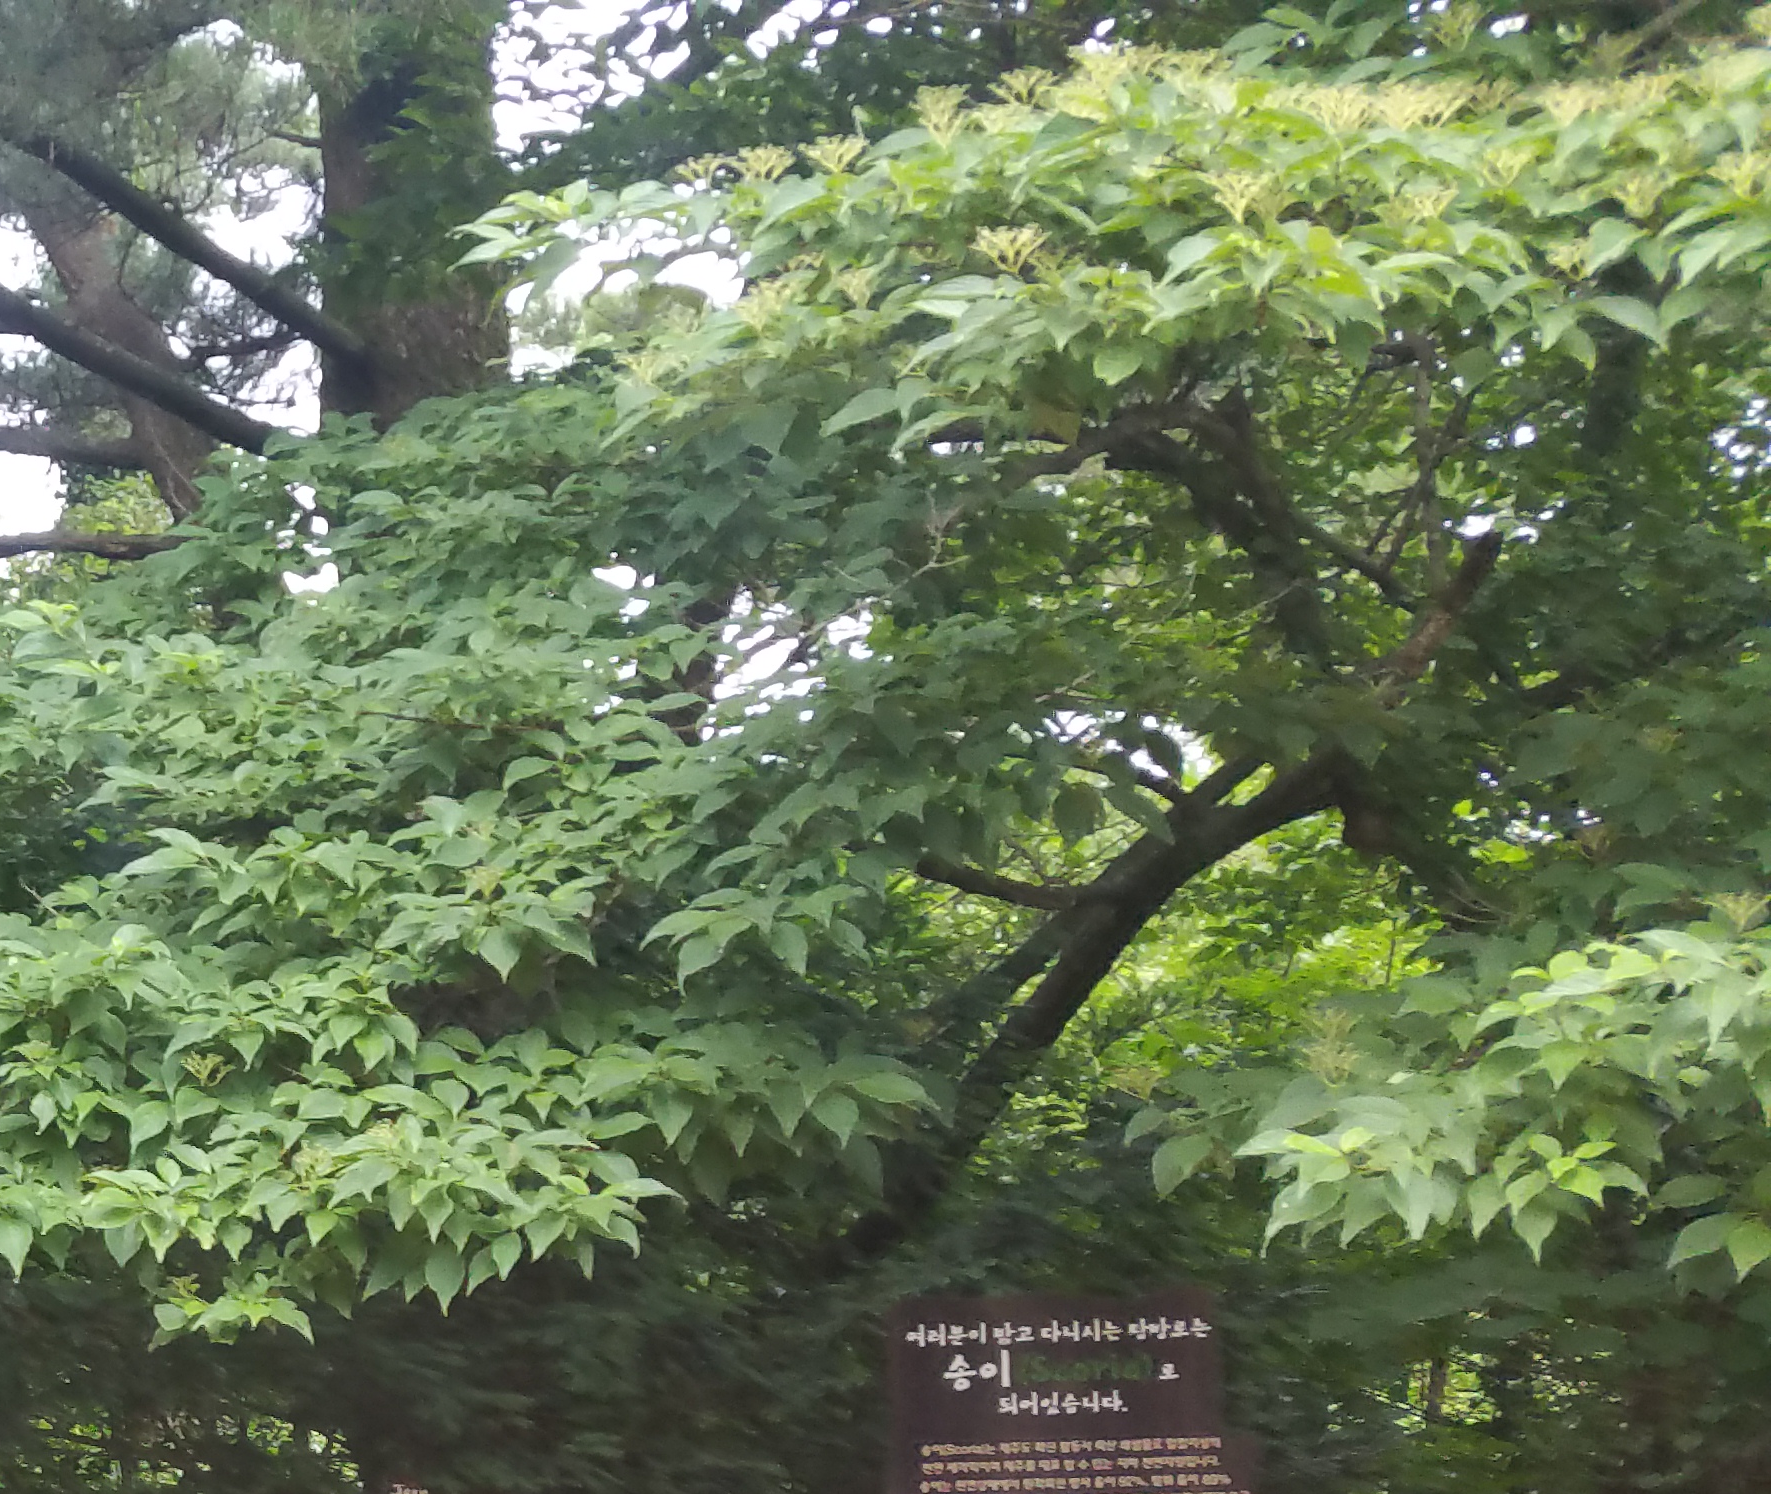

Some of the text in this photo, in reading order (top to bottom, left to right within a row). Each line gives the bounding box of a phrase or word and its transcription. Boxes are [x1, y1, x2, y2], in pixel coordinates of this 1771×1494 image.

[905, 1322, 986, 1347] 여러분이
[1040, 1318, 1123, 1342] 다니시는
[1128, 1317, 1212, 1340] 탐방로는
[943, 1349, 1012, 1391] 송이
[1158, 1363, 1181, 1380] 로
[998, 1390, 1128, 1415] 되어있습니다.
